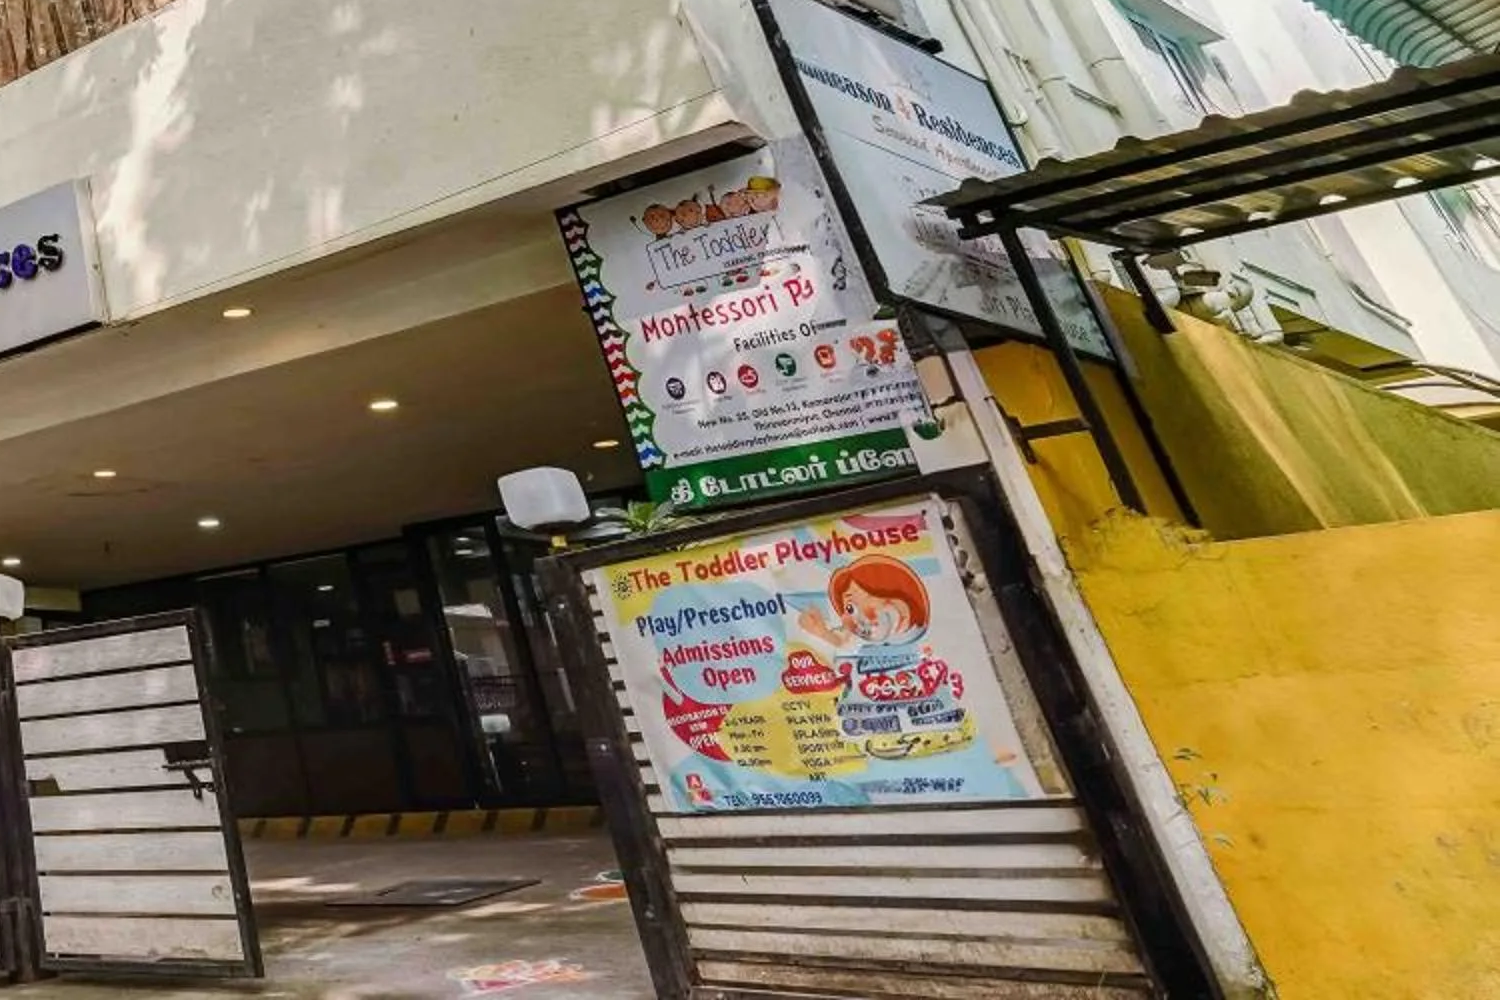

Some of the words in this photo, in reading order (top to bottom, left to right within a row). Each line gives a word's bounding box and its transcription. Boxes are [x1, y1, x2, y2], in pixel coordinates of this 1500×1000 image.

[654, 243, 696, 271] The
[694, 222, 770, 261] Toddler
[640, 285, 779, 343] Montessori
[734, 329, 797, 352] Facilities
[628, 569, 671, 593] The
[676, 550, 770, 582] Toddler
[776, 522, 919, 565] Playhouse
[636, 592, 787, 637] Play/Preschool
[662, 635, 775, 668] Admissions
[703, 666, 757, 692] Open
